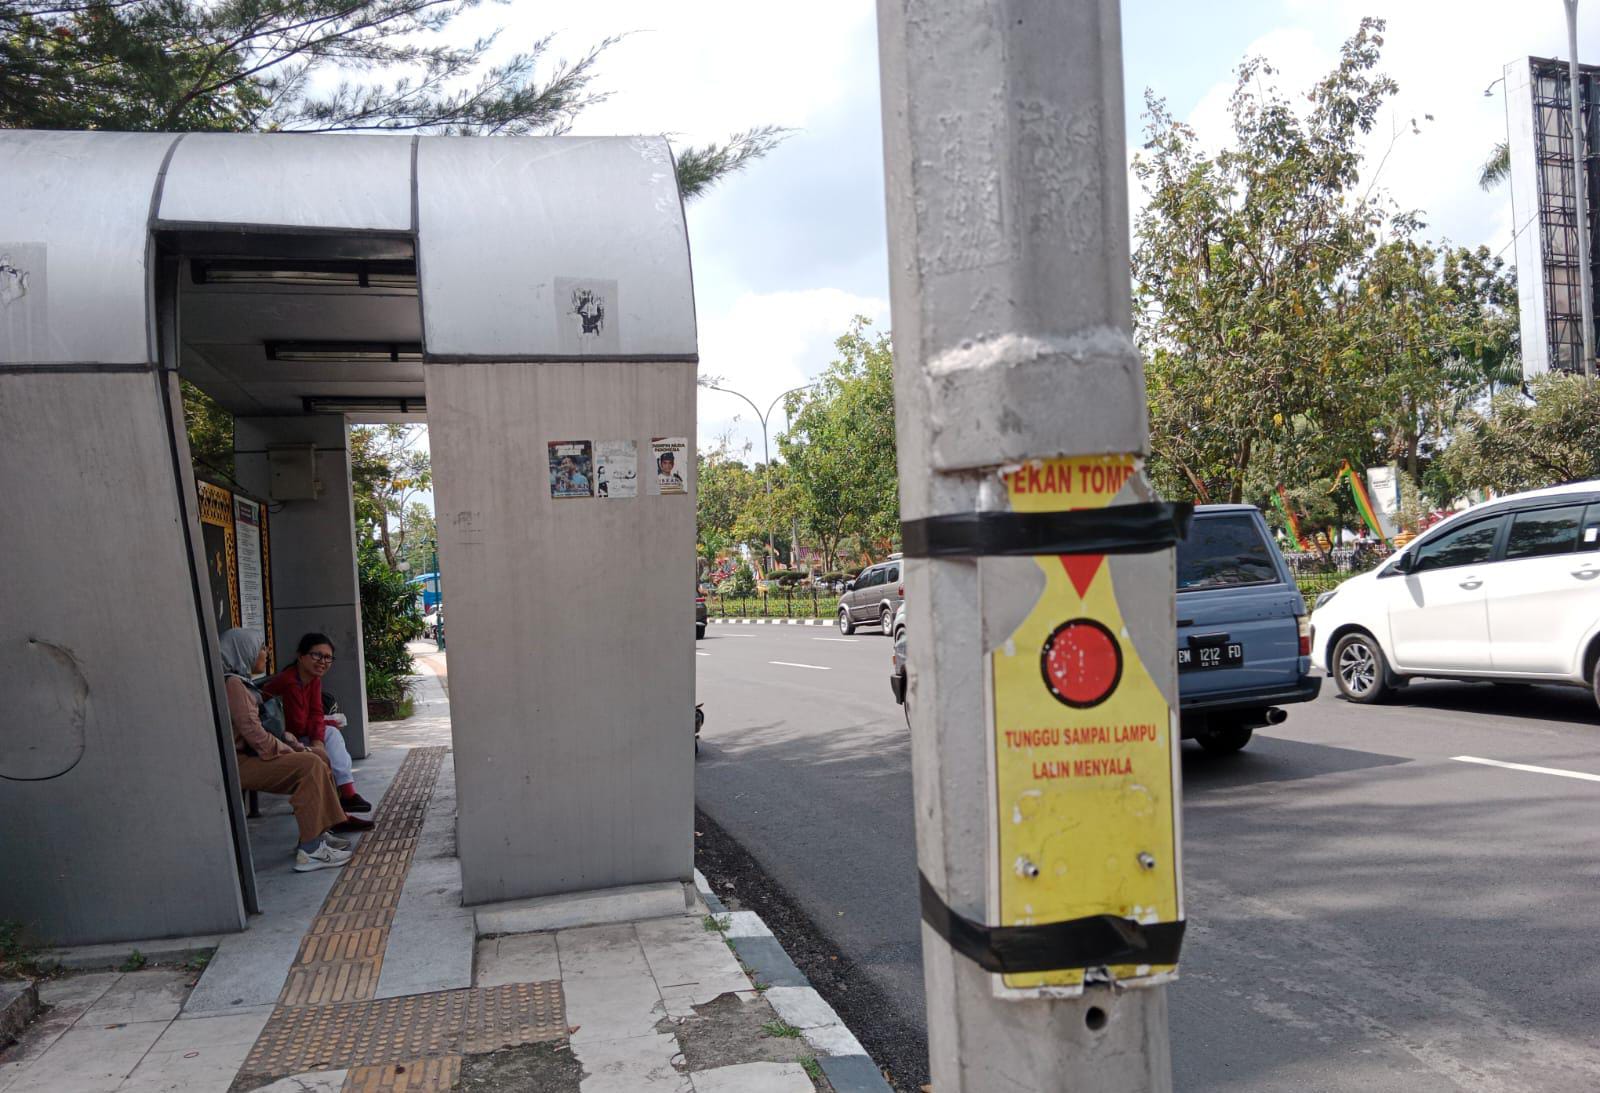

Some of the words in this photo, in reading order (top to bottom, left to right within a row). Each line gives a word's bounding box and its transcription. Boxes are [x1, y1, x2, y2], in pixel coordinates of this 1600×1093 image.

[1003, 464, 1072, 494] EKAN
[1200, 647, 1221, 661] 1212
[1005, 728, 1060, 748] TUNGGU
[1064, 726, 1110, 745] SAMPAI
[1114, 724, 1157, 743] LAMPU
[1033, 761, 1070, 780] LALIN
[1074, 758, 1133, 777] MENYALA
